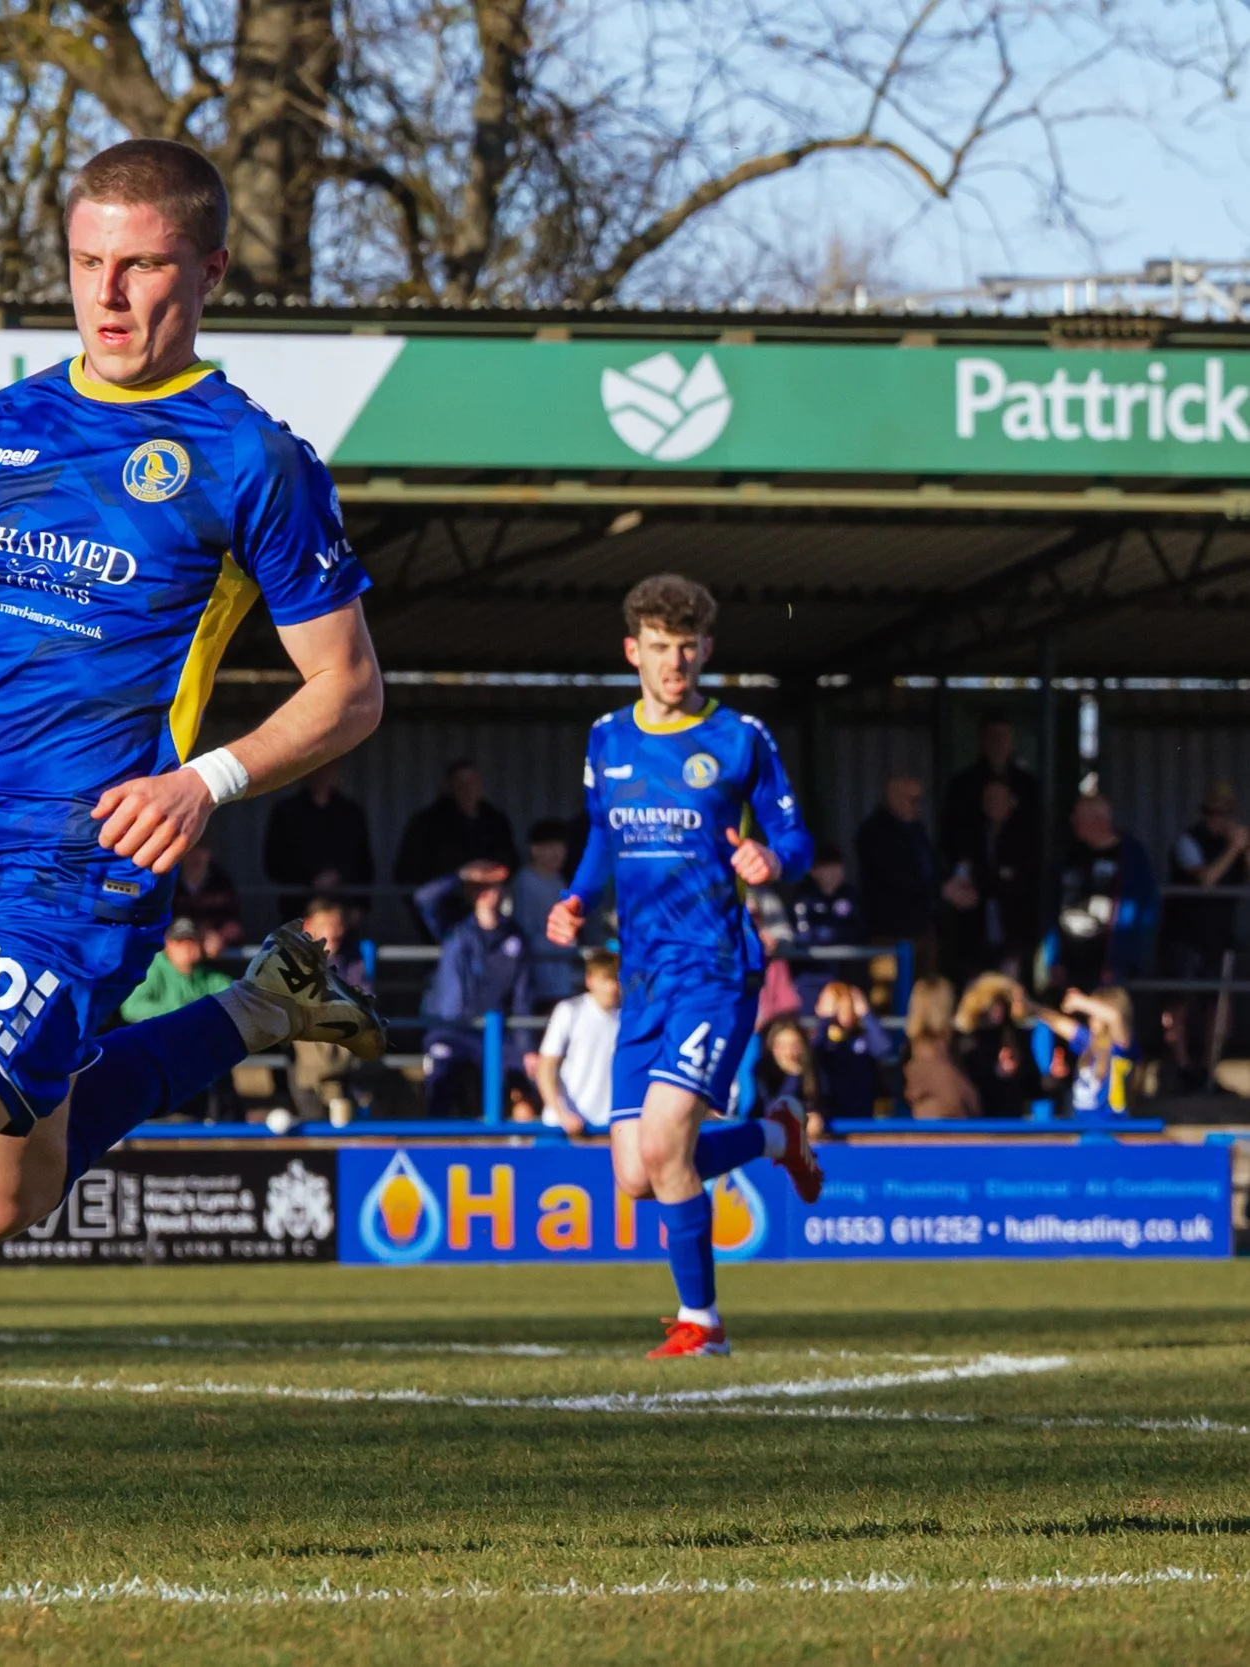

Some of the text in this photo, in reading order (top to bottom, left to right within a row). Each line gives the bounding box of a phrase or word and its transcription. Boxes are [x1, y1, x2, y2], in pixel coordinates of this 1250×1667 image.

[954, 355, 1250, 444] Pattrick
[608, 806, 702, 831] CHARMED
[679, 1021, 711, 1068] 4
[447, 1164, 669, 1251] Hal
[2, 1240, 93, 1260] SUPPORT
[804, 1213, 1214, 1249] 01553 611252 hallheating.co.uk
